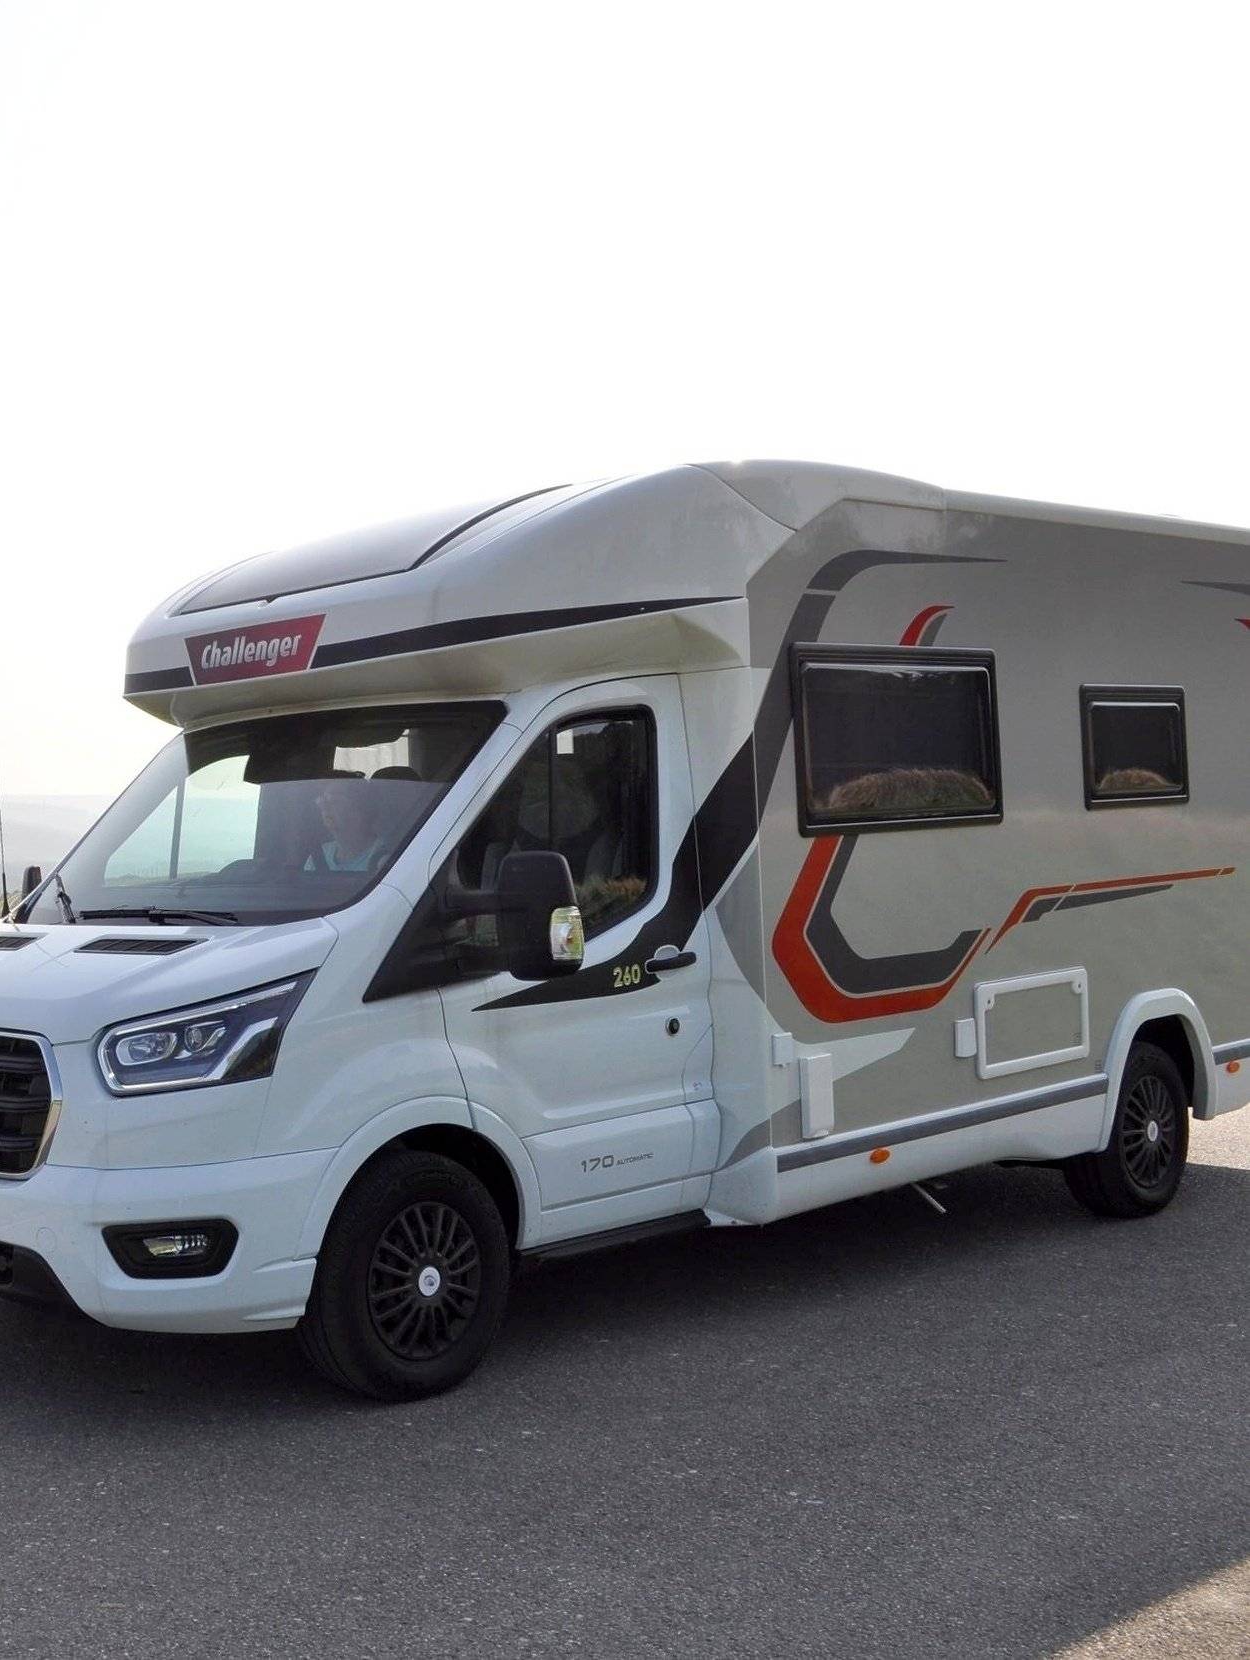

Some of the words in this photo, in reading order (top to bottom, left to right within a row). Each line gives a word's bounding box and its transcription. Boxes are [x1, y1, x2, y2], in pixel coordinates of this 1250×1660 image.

[201, 635, 302, 669] Challenger
[613, 963, 641, 988] 260
[581, 1155, 614, 1173] 170
